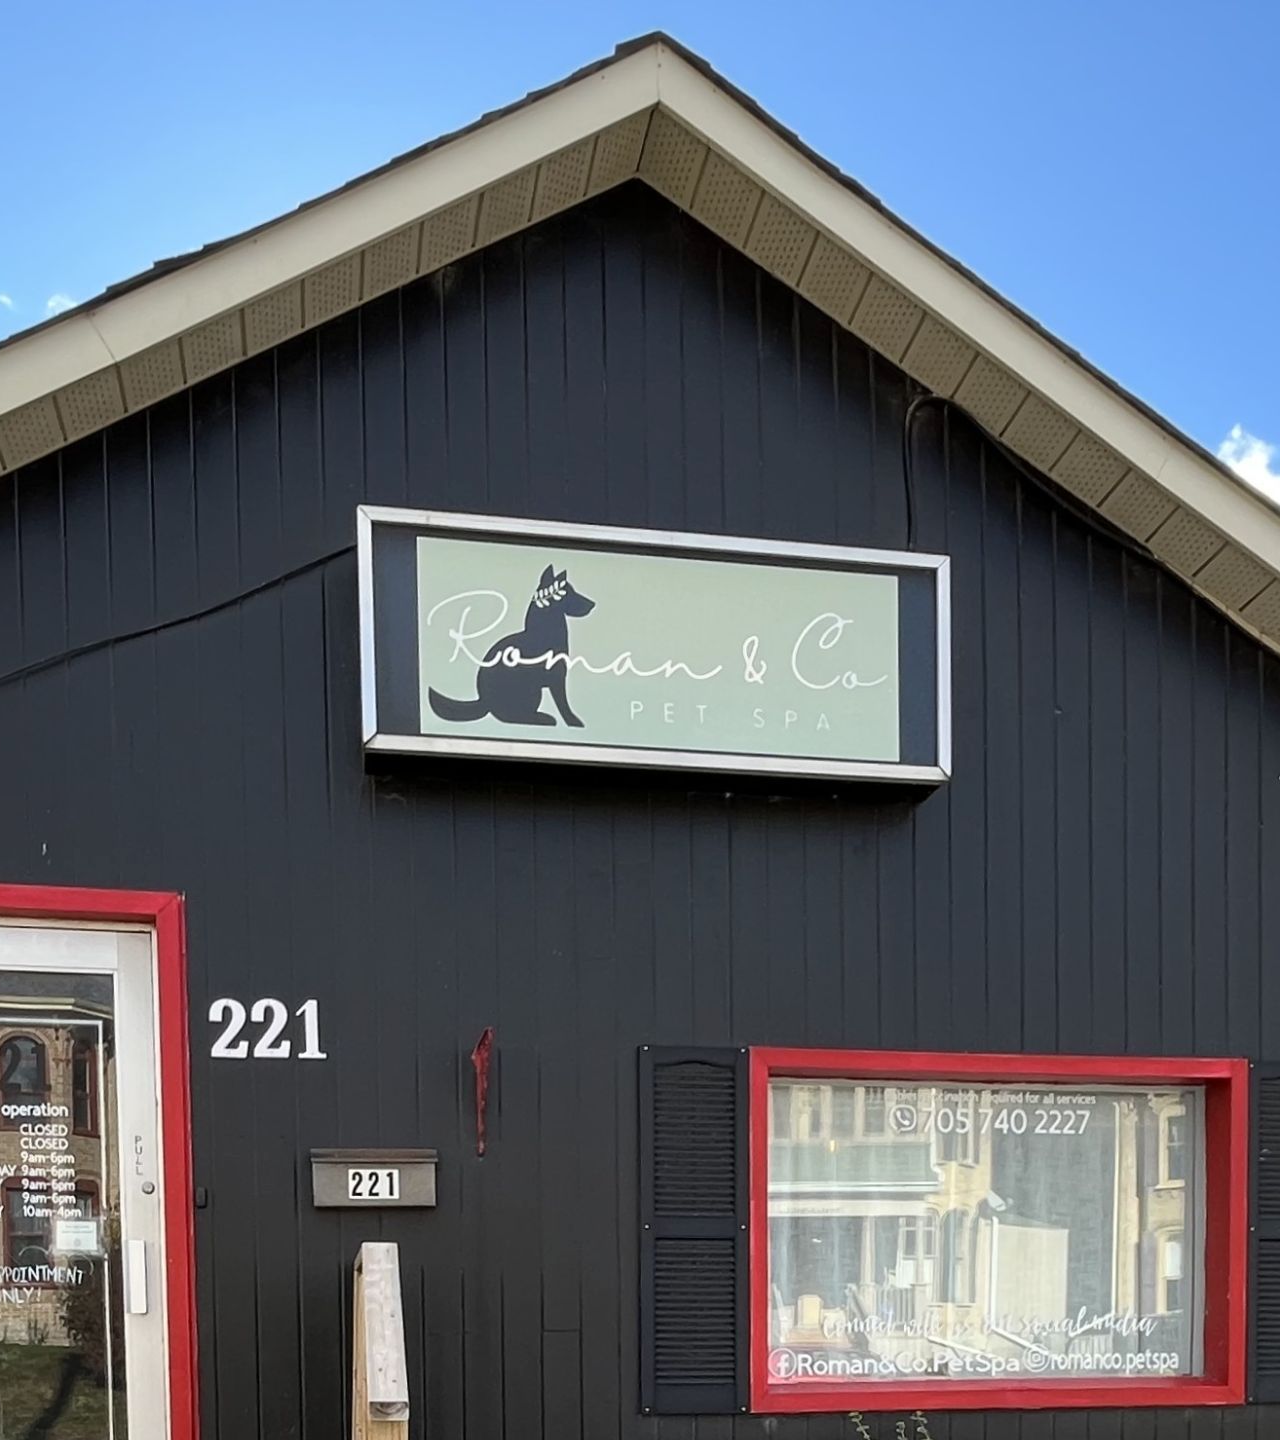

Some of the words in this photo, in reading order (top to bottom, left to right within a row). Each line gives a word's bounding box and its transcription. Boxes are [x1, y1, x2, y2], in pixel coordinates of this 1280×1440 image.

[426, 589, 723, 680] Roman
[741, 635, 768, 685] &
[630, 700, 708, 725] PET
[753, 707, 832, 732] SPA
[208, 997, 328, 1060] 221
[1025, 1091, 1041, 1104] for
[1042, 1093, 1055, 1105] all
[1056, 1094, 1097, 1105] services
[1, 1101, 69, 1119] operation
[921, 1108, 970, 1135] 705
[978, 1108, 1028, 1135] 740
[1033, 1109, 1091, 1135] 2227
[19, 1123, 68, 1137] CLOSED
[20, 1137, 69, 1150] CLOSED
[20, 1151, 75, 1165] 9am-6pm
[134, 1135, 144, 1176] PULL
[21, 1165, 76, 1178] 9am-6pm
[21, 1179, 76, 1192] 9am-6pm
[350, 1171, 396, 1197] 221
[21, 1192, 77, 1205] 9am-6pm
[22, 1206, 82, 1219] 10am-4pm
[796, 1351, 1020, 1377] Roman&Co.PetSpa
[1050, 1351, 1180, 1375] romanco.petspa
